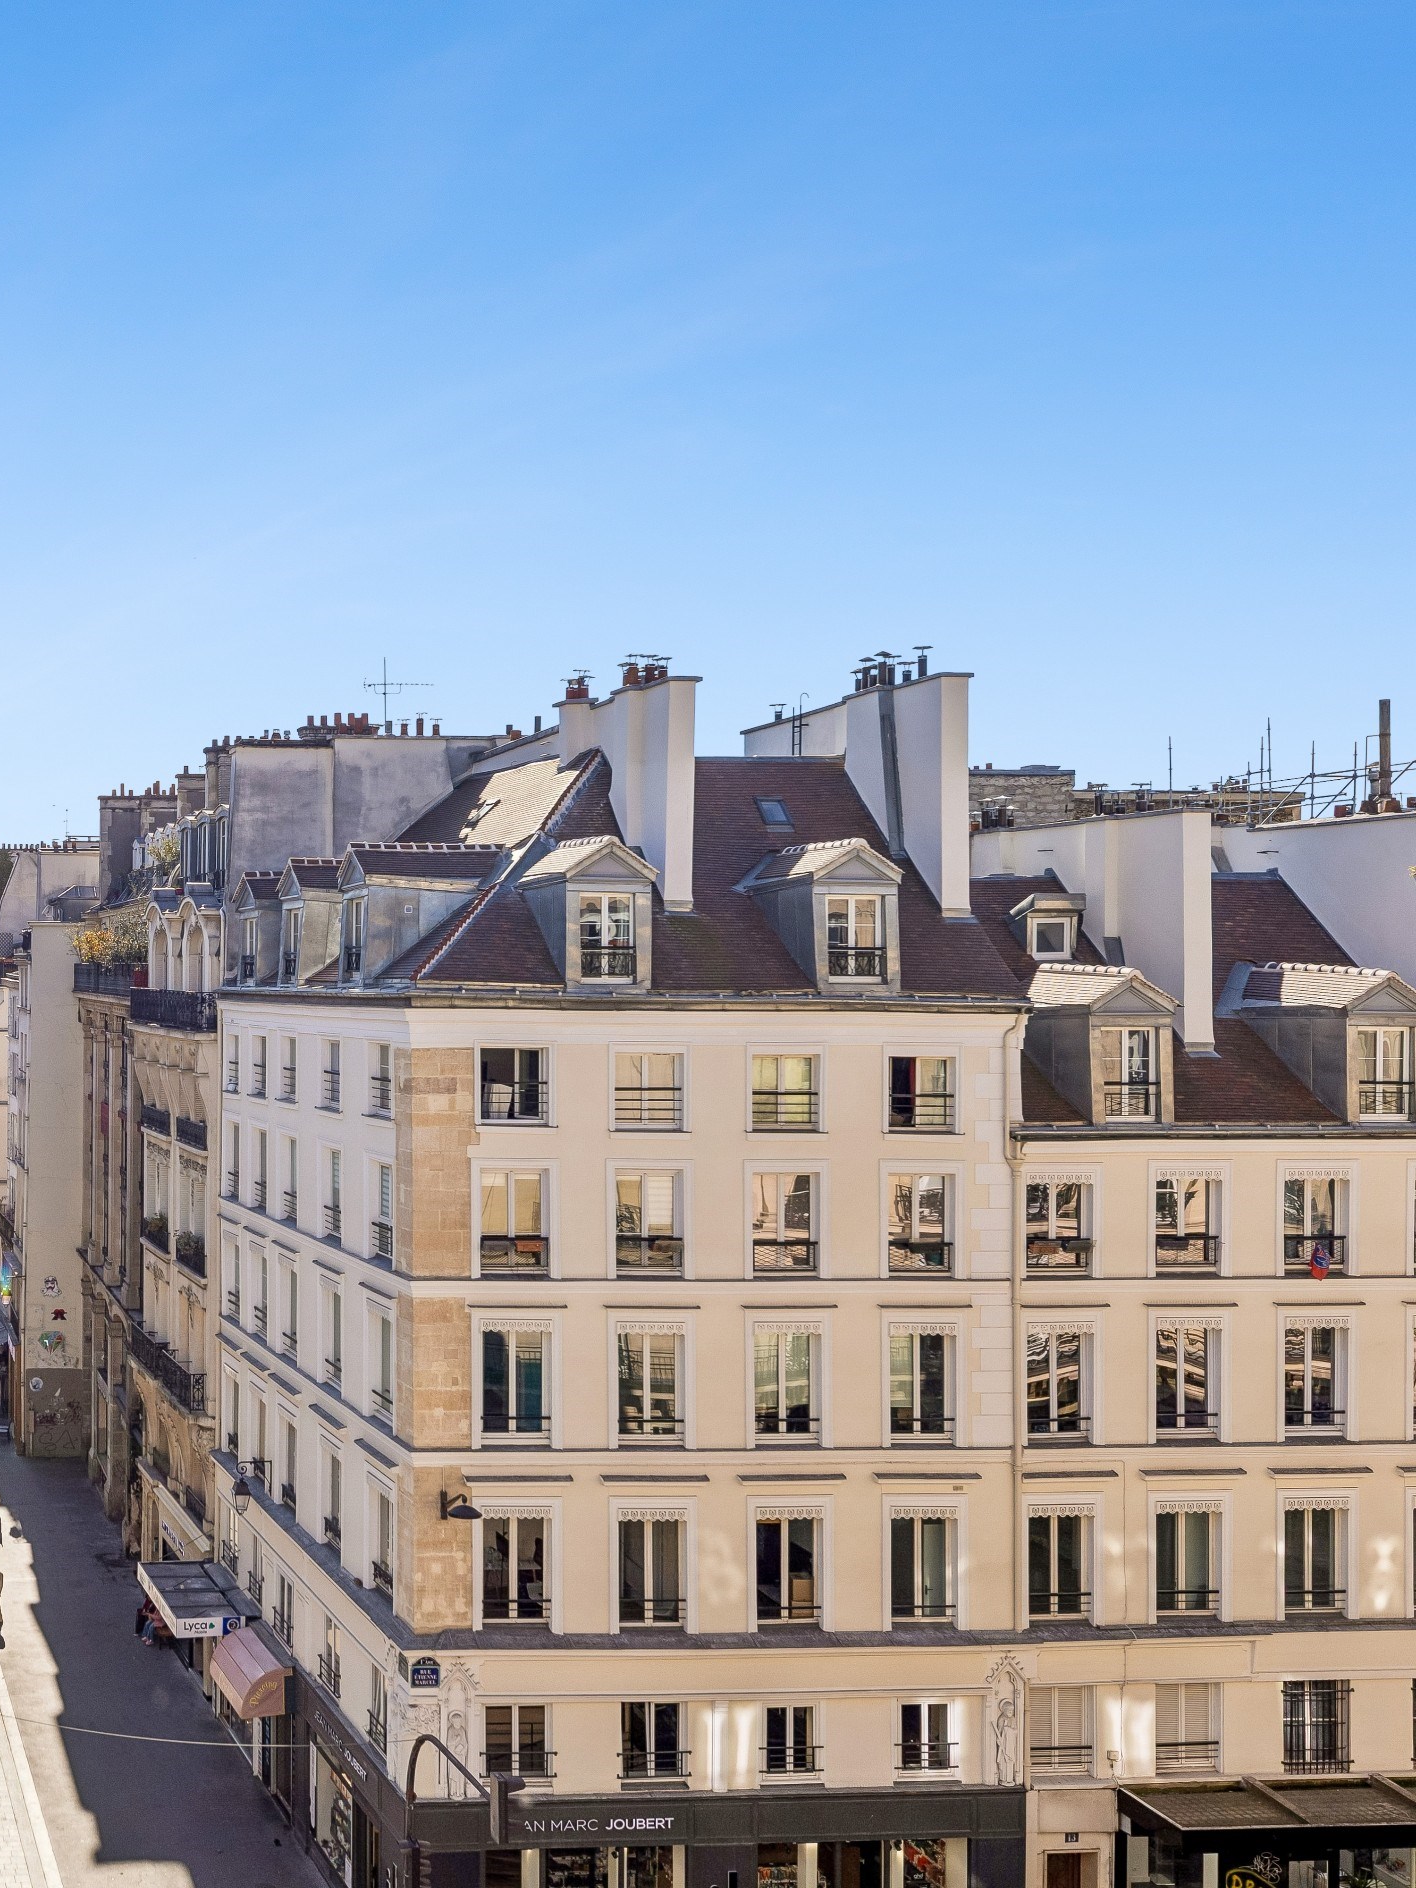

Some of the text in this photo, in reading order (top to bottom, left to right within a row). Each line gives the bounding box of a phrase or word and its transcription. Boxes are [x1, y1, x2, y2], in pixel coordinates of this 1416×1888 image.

[183, 1621, 208, 1632] Lyca
[344, 1747, 367, 1782] JOUBERT
[524, 1817, 675, 1832] AN MARC JOUBERT
[1067, 1833, 1077, 1842] 13
